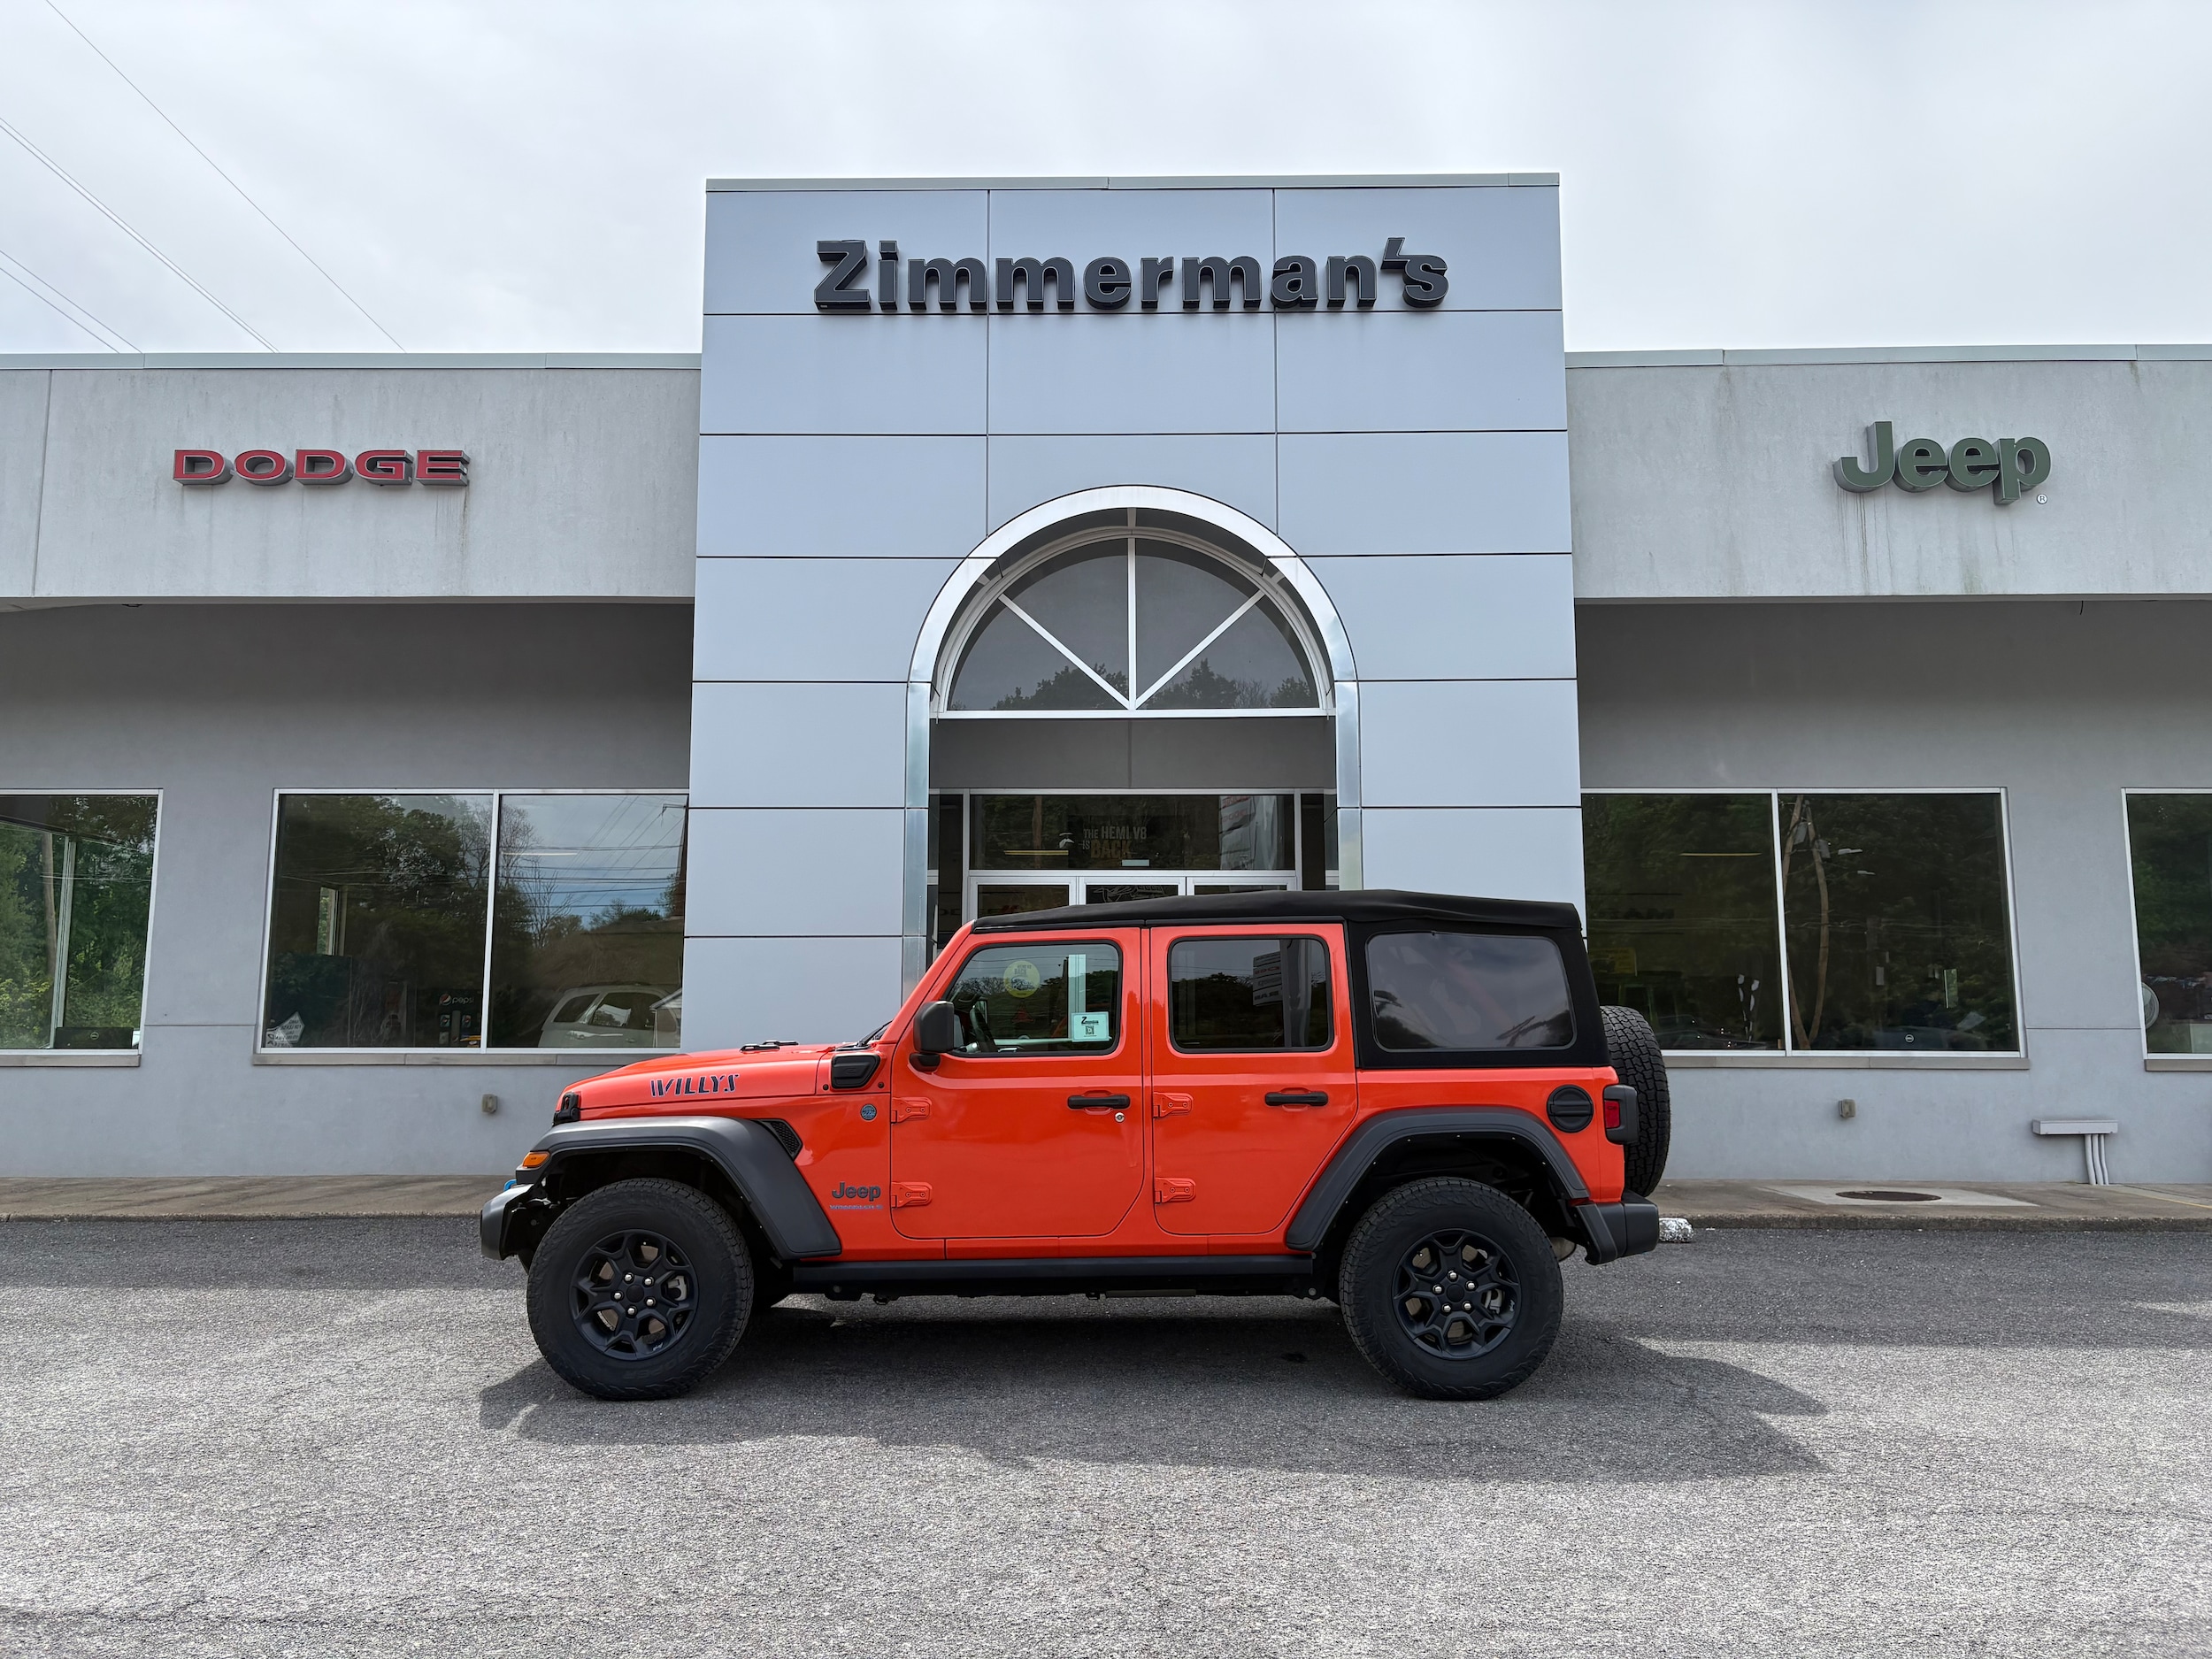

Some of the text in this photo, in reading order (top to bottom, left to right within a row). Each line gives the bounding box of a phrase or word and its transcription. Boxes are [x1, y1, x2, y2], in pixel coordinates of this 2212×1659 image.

[813, 236, 1449, 311] Zimmerman's
[173, 449, 470, 487] DODGE
[1832, 421, 2051, 505] Jeep
[1082, 828, 1099, 839] THE
[1133, 826, 1148, 840] V8
[1082, 839, 1133, 858] IS BACK
[650, 1073, 740, 1097] WILLYS
[832, 1180, 881, 1202] Jeep
